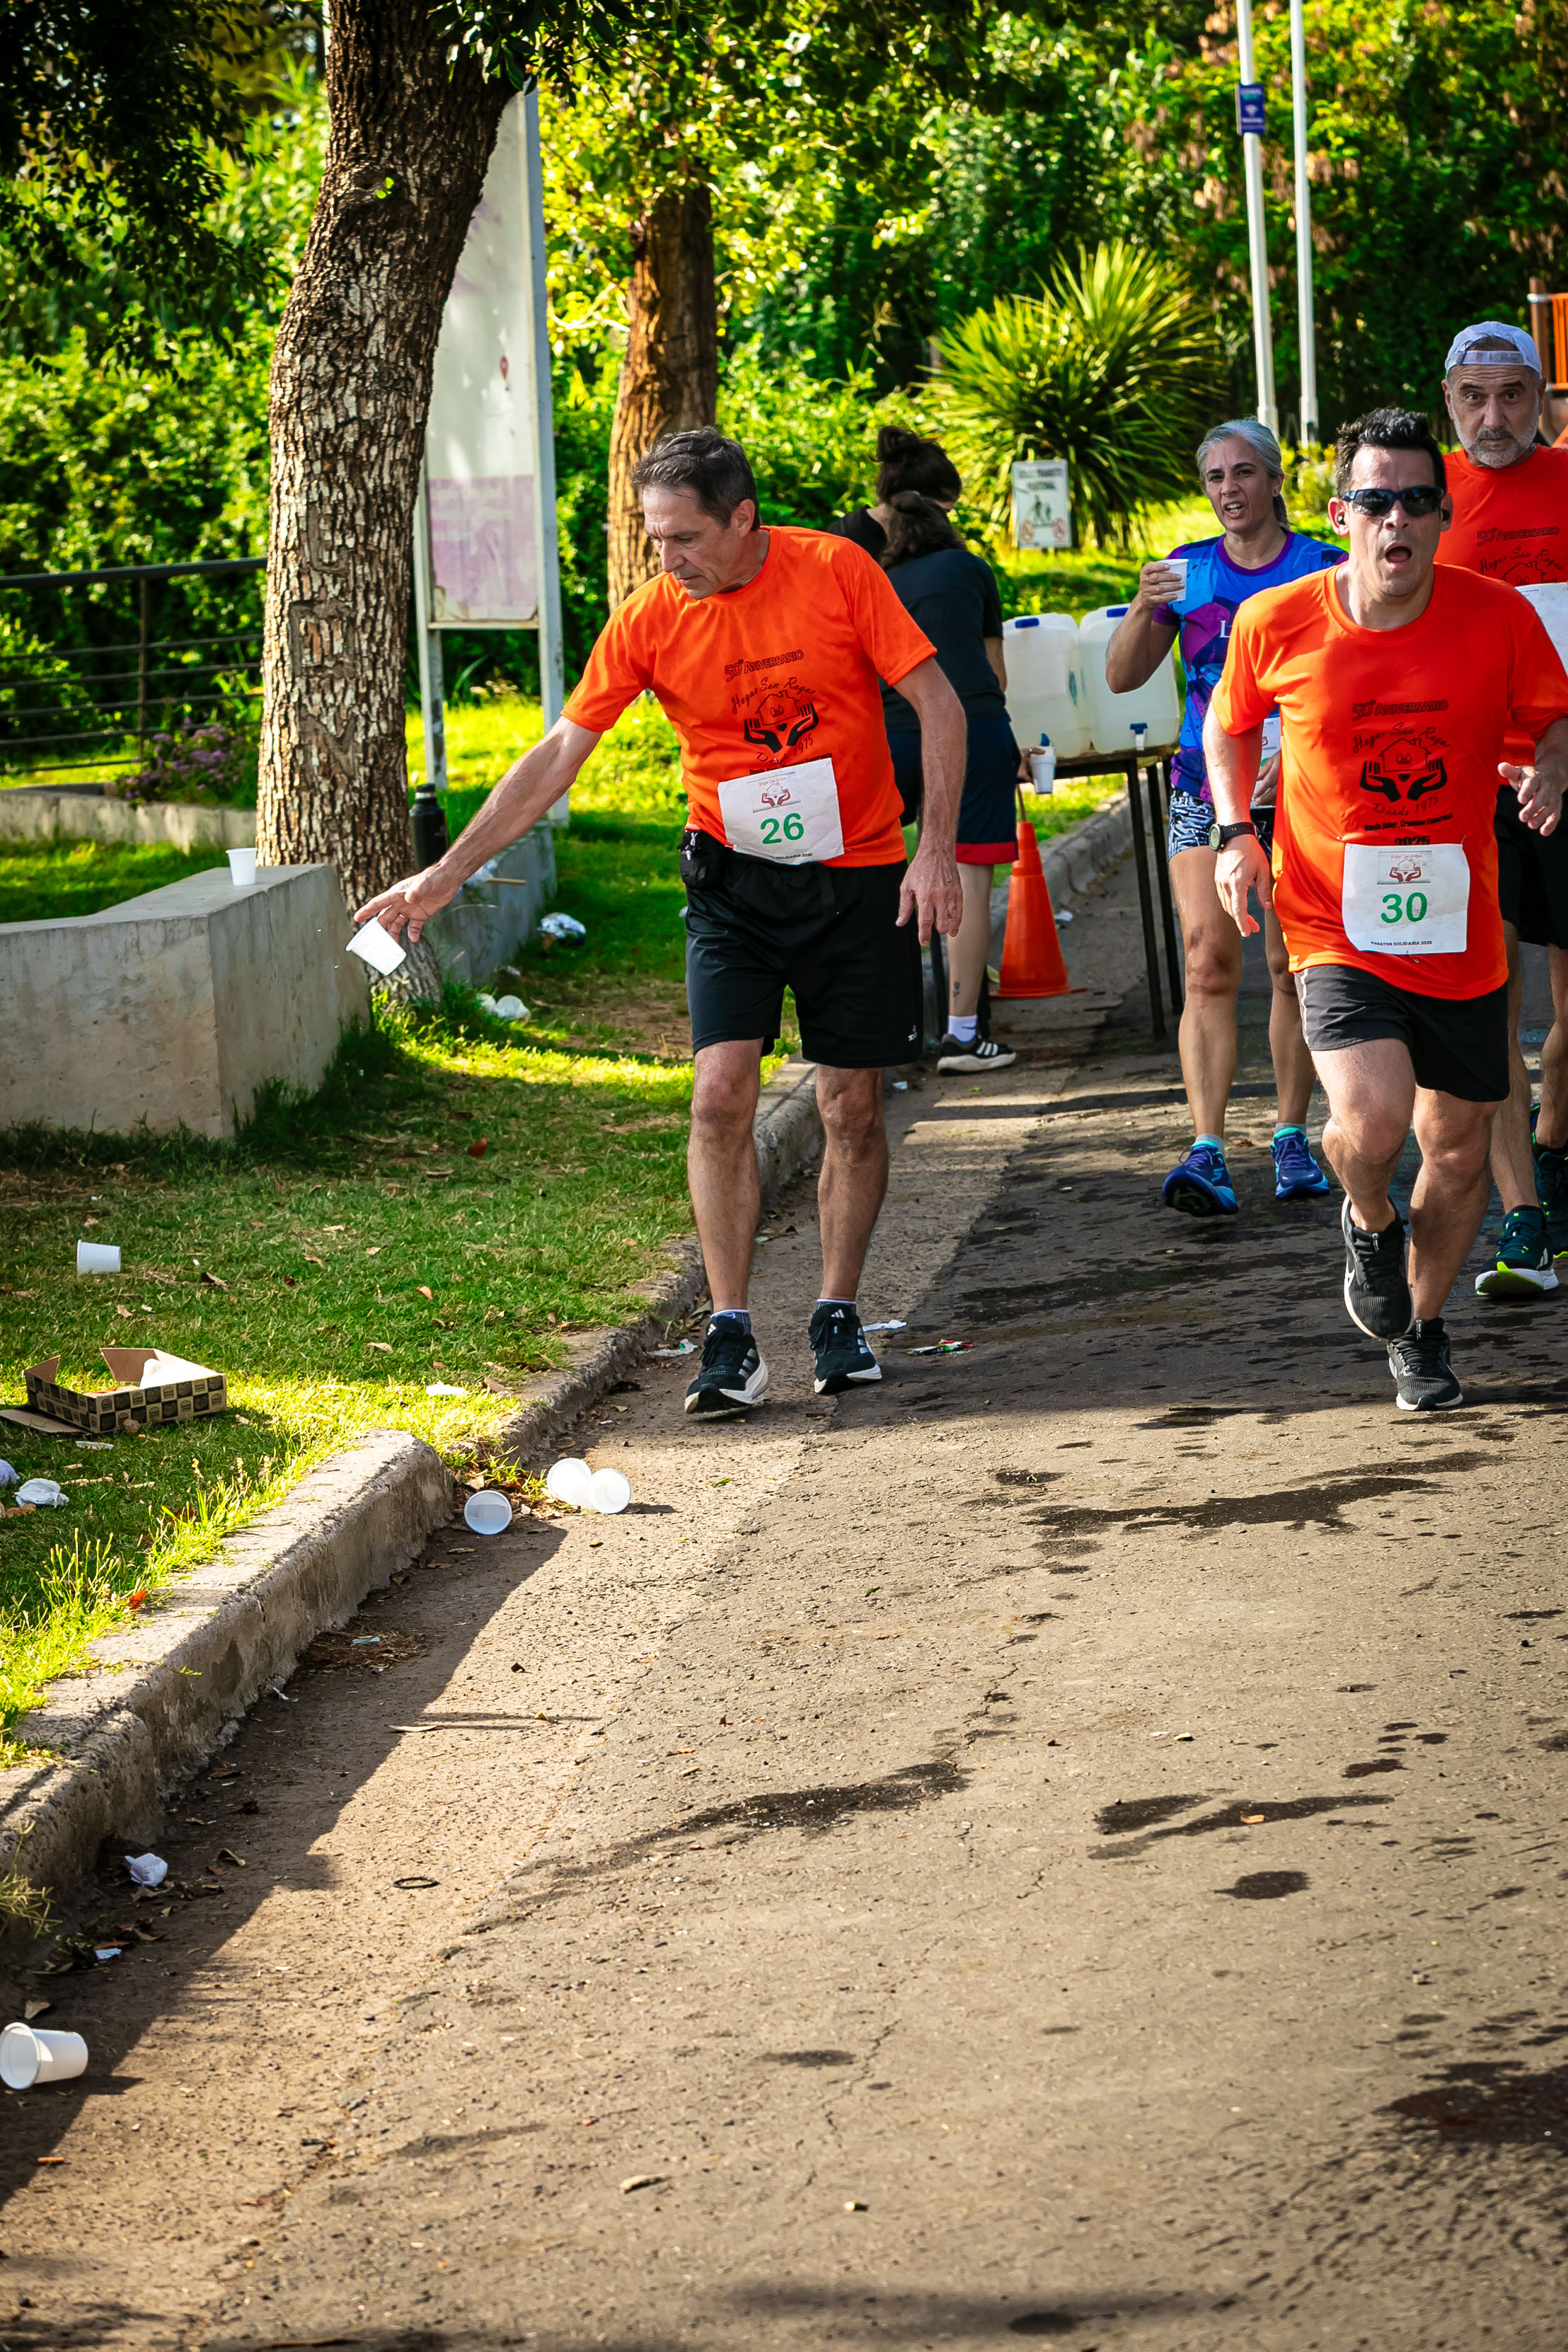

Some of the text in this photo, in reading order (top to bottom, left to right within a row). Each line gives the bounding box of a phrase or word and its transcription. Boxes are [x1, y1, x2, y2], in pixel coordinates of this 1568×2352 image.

[1510, 546, 1531, 560] San
[760, 676, 779, 692] San
[1389, 722, 1415, 736] San
[793, 733, 814, 756] 1975
[1373, 792, 1439, 817] Desde 1975
[760, 812, 805, 845] 26
[1380, 892, 1428, 923] 30
